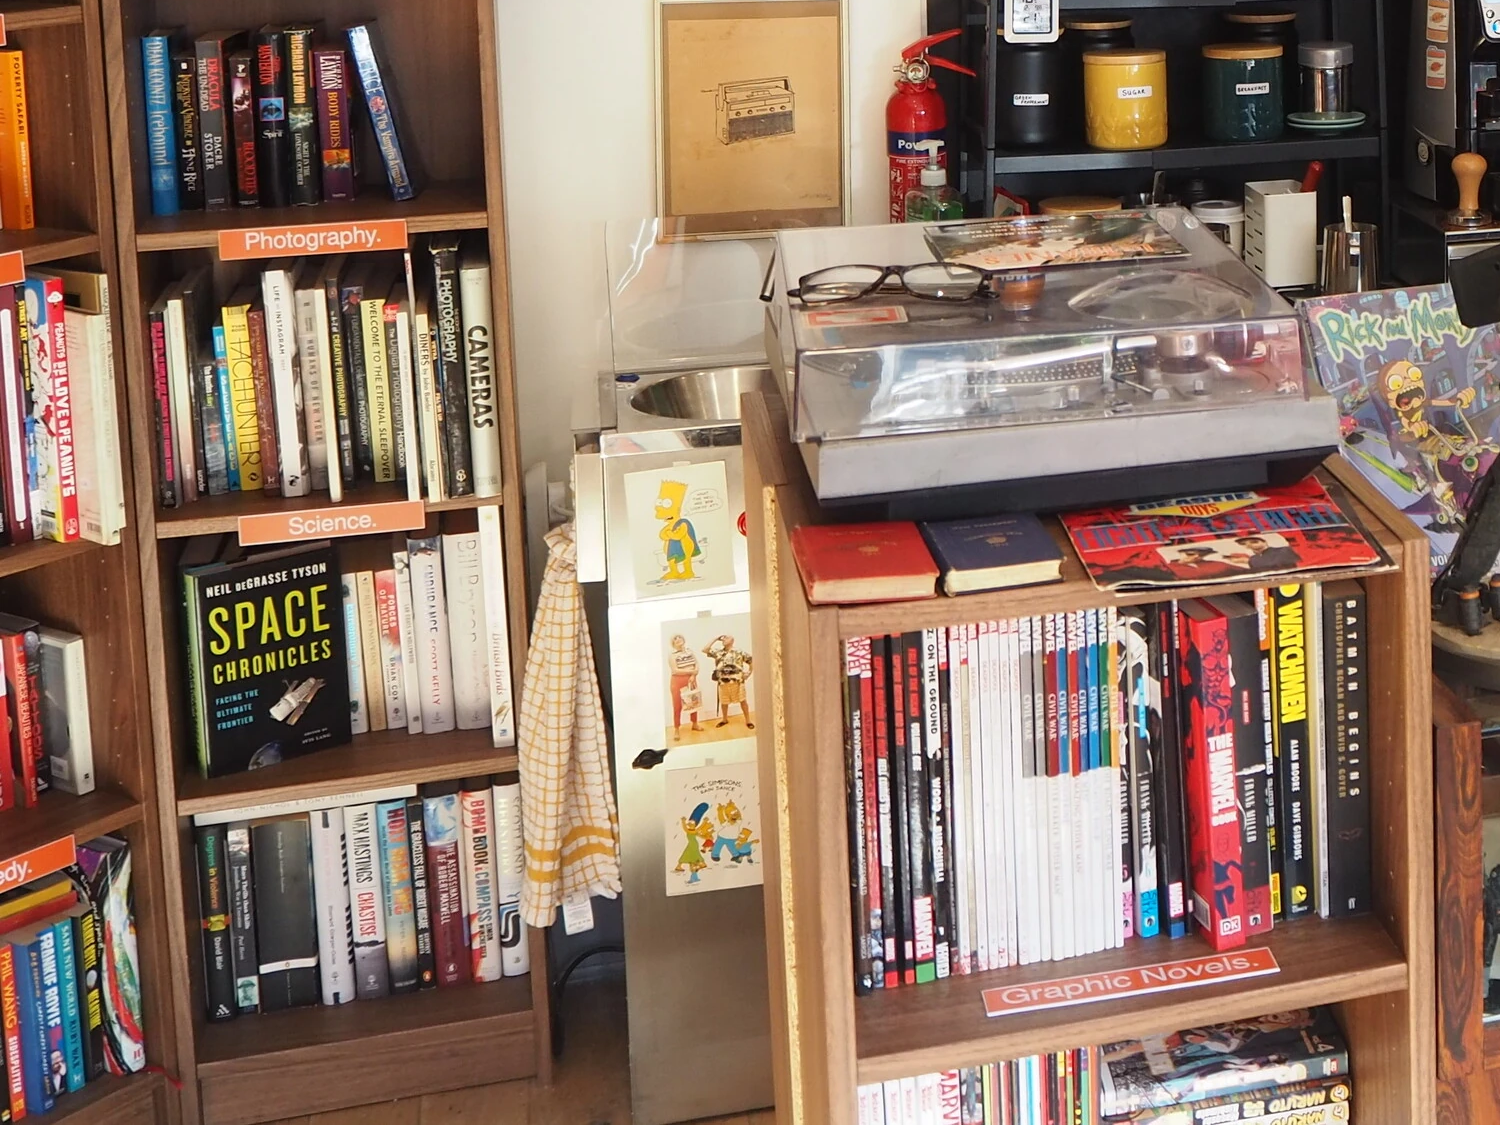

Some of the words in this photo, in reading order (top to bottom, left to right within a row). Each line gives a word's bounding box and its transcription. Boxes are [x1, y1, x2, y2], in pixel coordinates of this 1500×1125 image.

[245, 227, 381, 250] Photography.
[53, 377, 70, 419] LOVE
[468, 324, 494, 430] CAMERAS
[56, 428, 76, 497] PEANUTS
[288, 514, 376, 535] Science.
[206, 583, 232, 598] NEIL
[292, 562, 327, 579] TYSON
[208, 584, 331, 656] SPACE
[1346, 600, 1358, 694] BATMAN
[212, 639, 332, 686] CHRONICLES
[1276, 599, 1307, 725] WATCHMEN
[1348, 711, 1360, 797] BEGINS
[1001, 970, 1134, 1006] Graphic
[1142, 956, 1259, 988] Novels.
